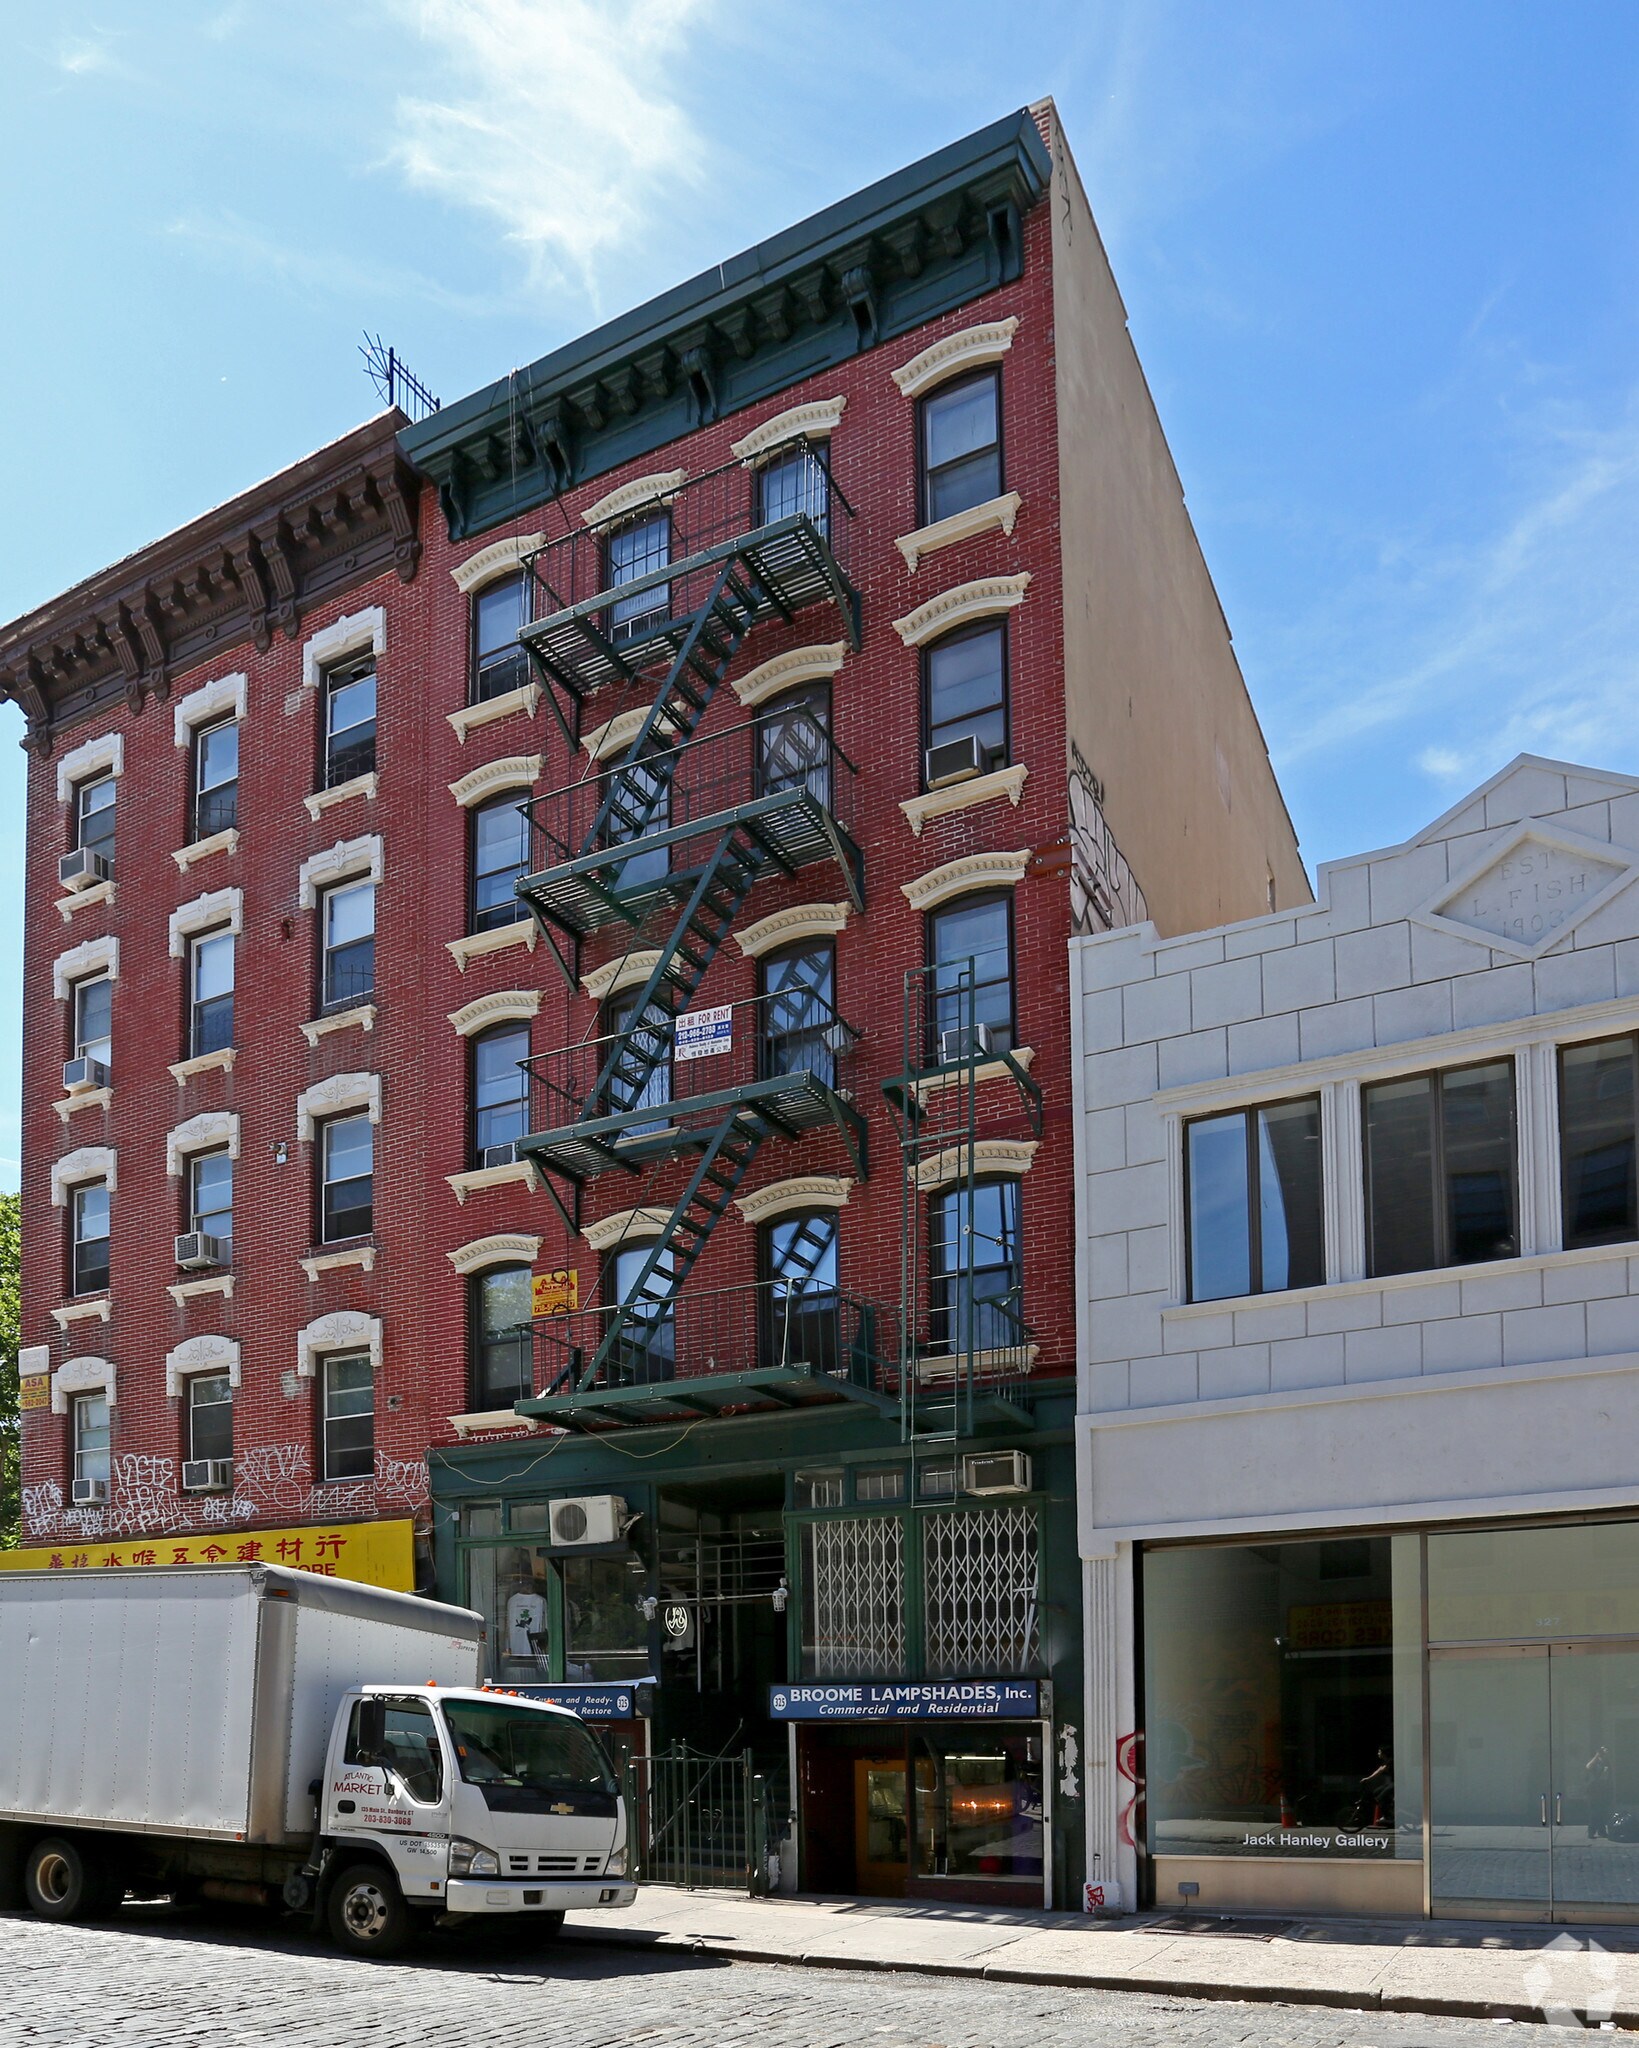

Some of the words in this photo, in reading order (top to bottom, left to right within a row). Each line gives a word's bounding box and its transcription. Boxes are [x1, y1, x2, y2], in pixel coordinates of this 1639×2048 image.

[1500, 850, 1556, 880] EST
[1508, 873, 1587, 909] FISH
[1501, 908, 1565, 937] 1903
[698, 1012, 711, 1025] FOR
[713, 1008, 729, 1021] RENT
[25, 1377, 44, 1388] ASA
[1535, 1617, 1561, 1627] 327
[790, 1688, 862, 1702] BROOME
[871, 1685, 1001, 1702] LAMPSHADES,
[1005, 1686, 1032, 1699] Inc.
[565, 1696, 581, 1704] and
[584, 1695, 613, 1706] Ready-
[618, 1698, 628, 1708] 325
[774, 1696, 785, 1708] 325
[581, 1707, 612, 1715] Restore
[818, 1704, 890, 1715] Commercial
[897, 1704, 919, 1714] and
[927, 1702, 1000, 1715] Residential
[343, 1771, 374, 1783] ATLANTIC
[333, 1782, 382, 1795] MARKET
[1243, 1833, 1276, 1846] Jack
[1280, 1833, 1331, 1849] Hanley
[1335, 1834, 1390, 1849] Gallery
